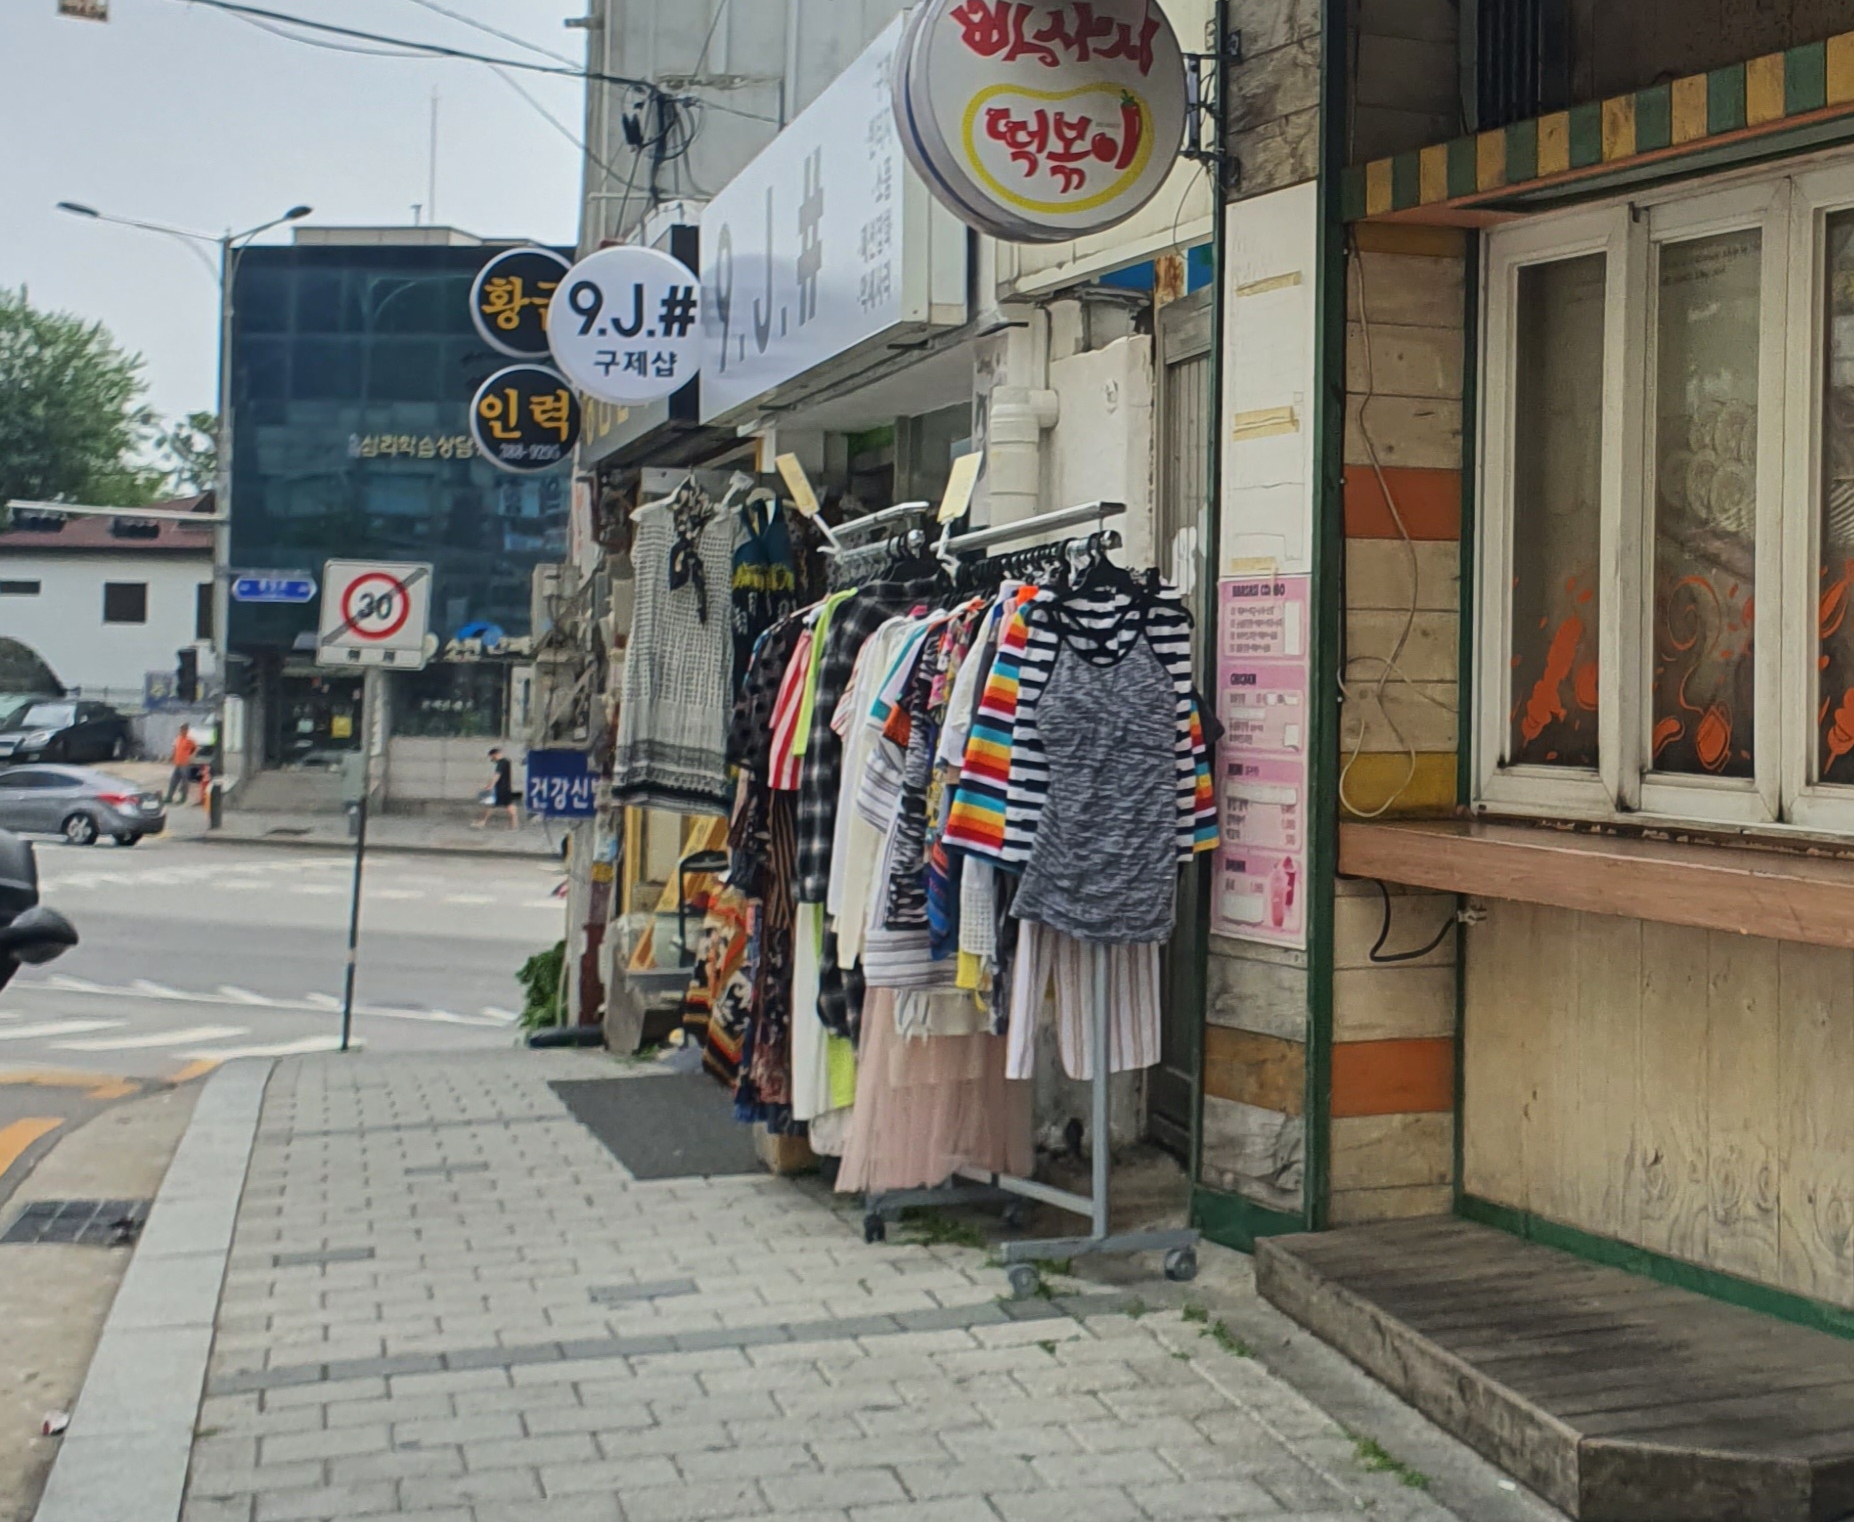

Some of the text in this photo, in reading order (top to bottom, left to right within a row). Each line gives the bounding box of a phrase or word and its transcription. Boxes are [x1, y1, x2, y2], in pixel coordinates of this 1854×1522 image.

[985, 96, 1143, 194] 떡볶이
[568, 280, 698, 338] 9.J.#
[594, 350, 678, 378] 구제샵
[478, 387, 570, 443] 인력
[360, 434, 480, 459] 심리학습상담
[357, 591, 394, 621] 30
